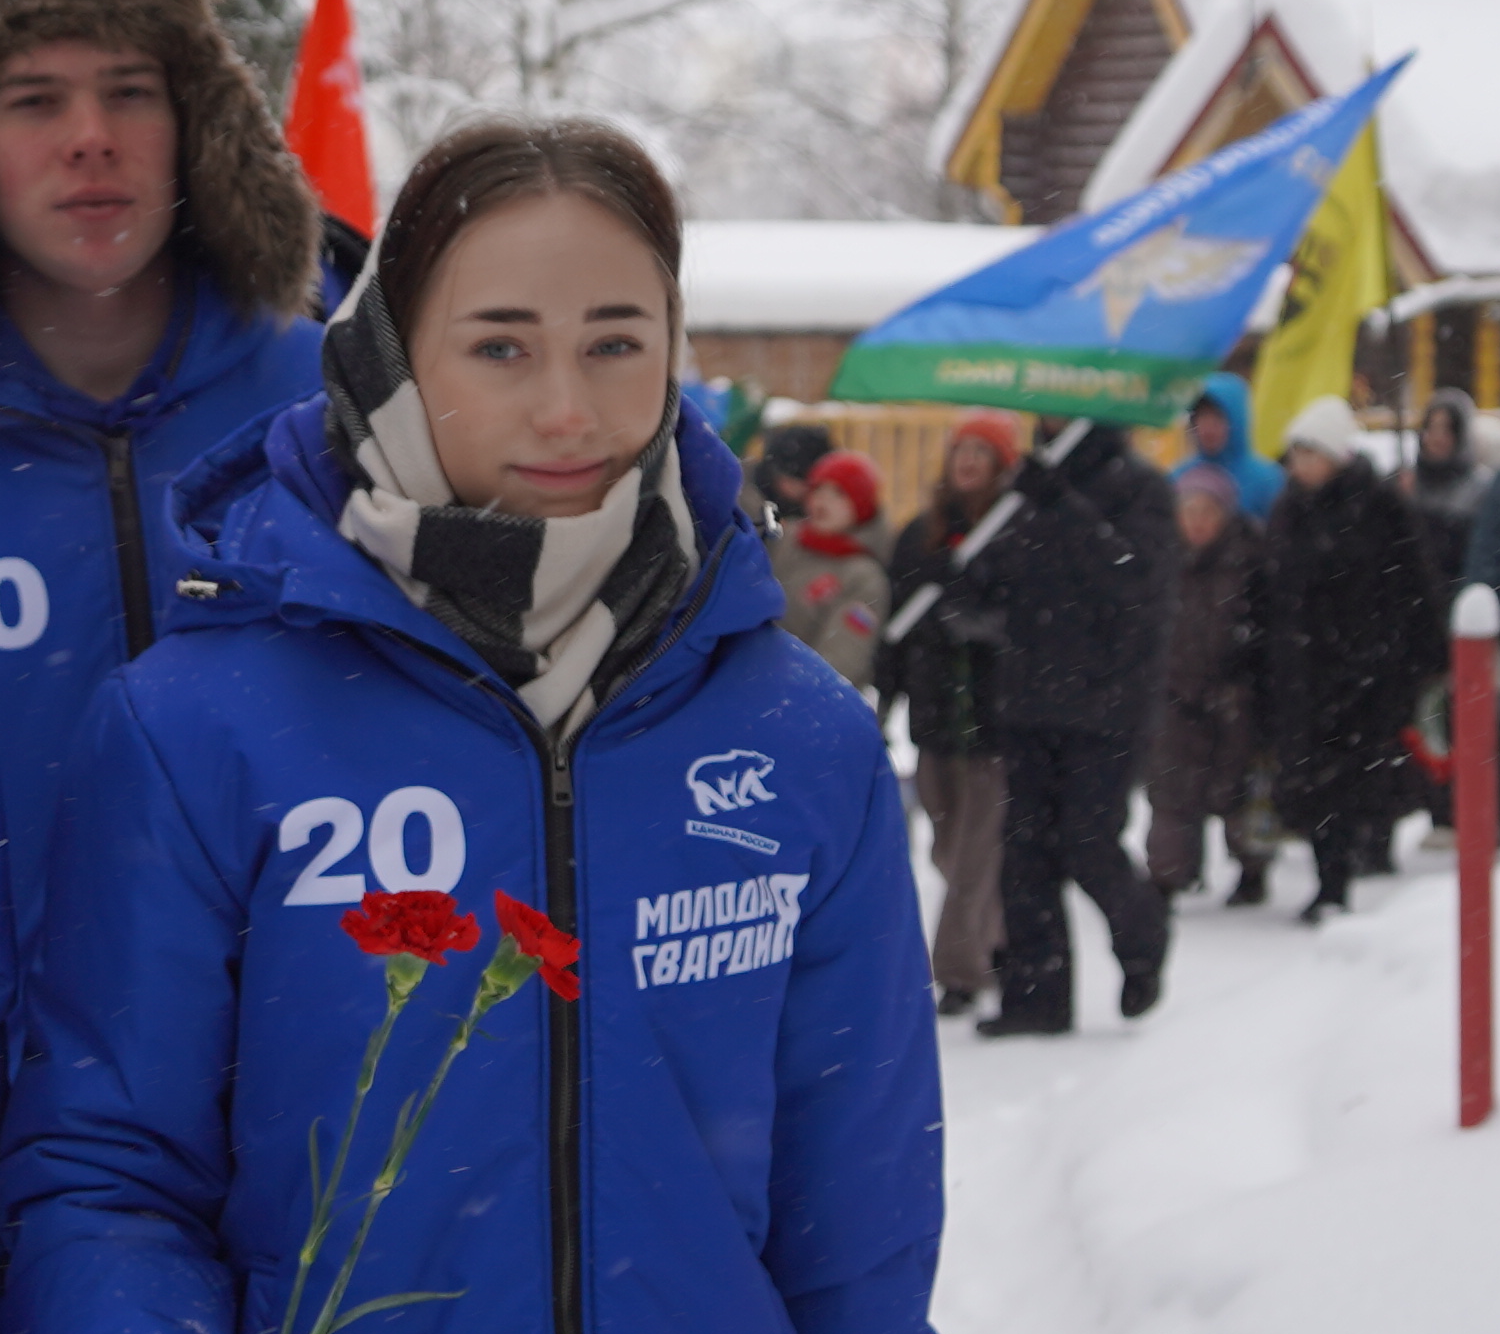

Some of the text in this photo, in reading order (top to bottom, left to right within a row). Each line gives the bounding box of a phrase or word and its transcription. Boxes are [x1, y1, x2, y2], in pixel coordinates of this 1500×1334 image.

[279, 785, 466, 906] 20
[632, 873, 810, 990] ГВАРДИЯ
[637, 873, 810, 960] МОЛОДАЯ
